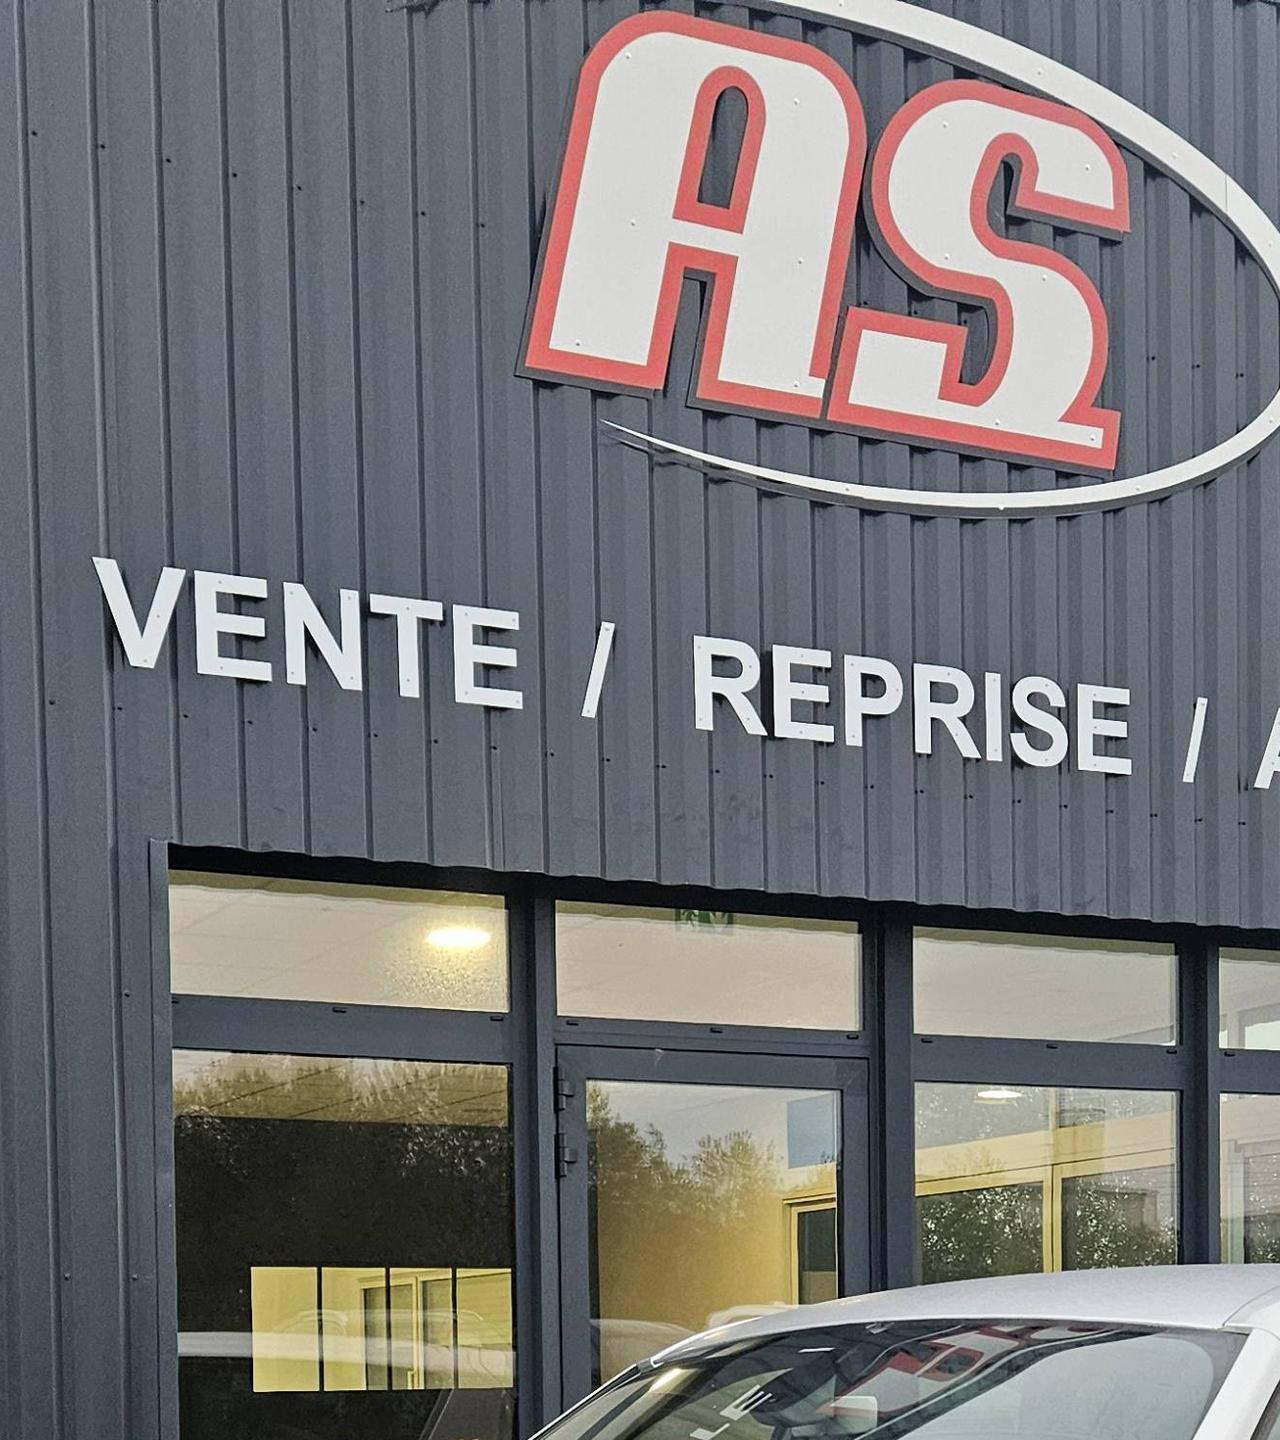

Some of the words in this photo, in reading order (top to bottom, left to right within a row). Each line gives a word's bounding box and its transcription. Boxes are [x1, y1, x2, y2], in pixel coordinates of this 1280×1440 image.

[524, 9, 1131, 470] AS
[92, 556, 523, 709] VENTE
[581, 622, 615, 718] /
[693, 635, 1133, 776] REPRISE
[1182, 697, 1208, 783] /
